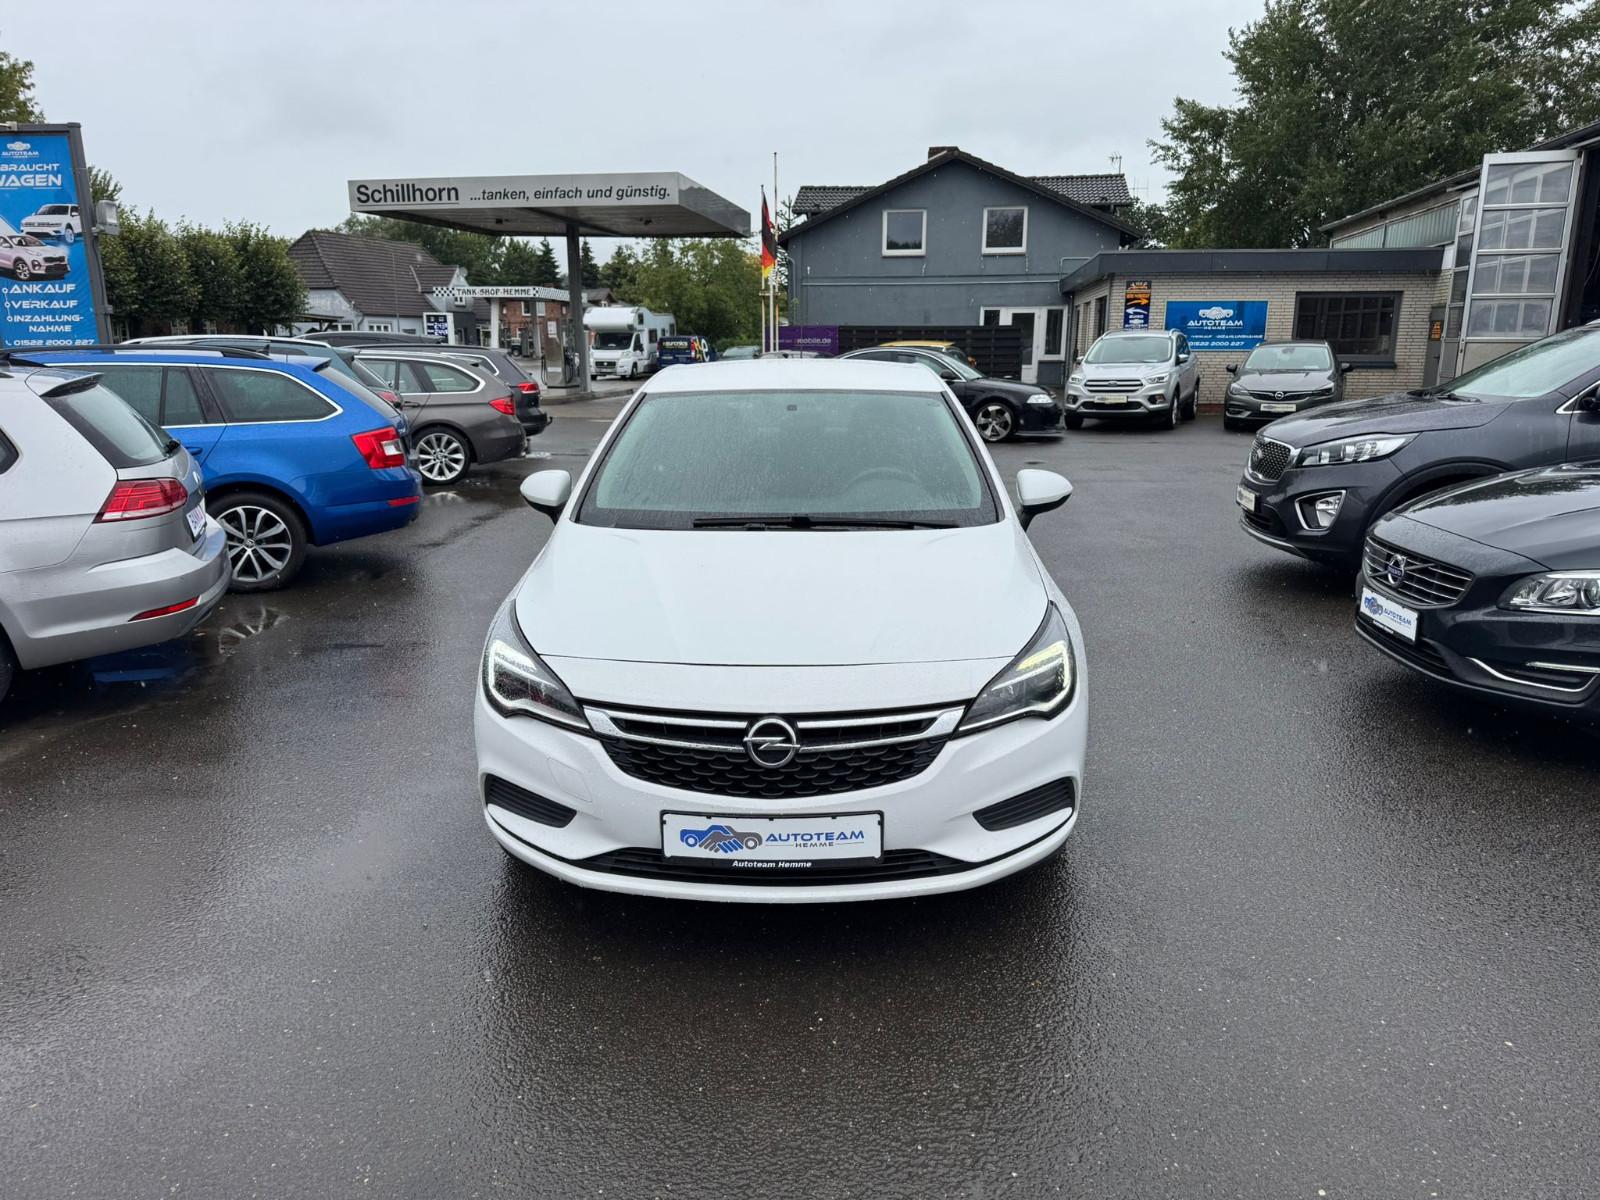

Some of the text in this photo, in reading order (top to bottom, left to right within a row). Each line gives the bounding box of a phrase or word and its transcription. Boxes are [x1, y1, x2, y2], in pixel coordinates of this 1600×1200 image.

[356, 183, 459, 204] Schillhorn
[534, 186, 582, 199] einfach
[587, 185, 612, 199] und
[616, 184, 670, 201] günstig.
[10, 284, 76, 294] ANKAUF
[11, 300, 78, 309] VERKAUF
[14, 314, 84, 322] INZAHLUNG-
[29, 325, 72, 333] NAHME
[766, 830, 865, 842] AUTOTEAM
[732, 860, 812, 868] Autoteam Hemme
